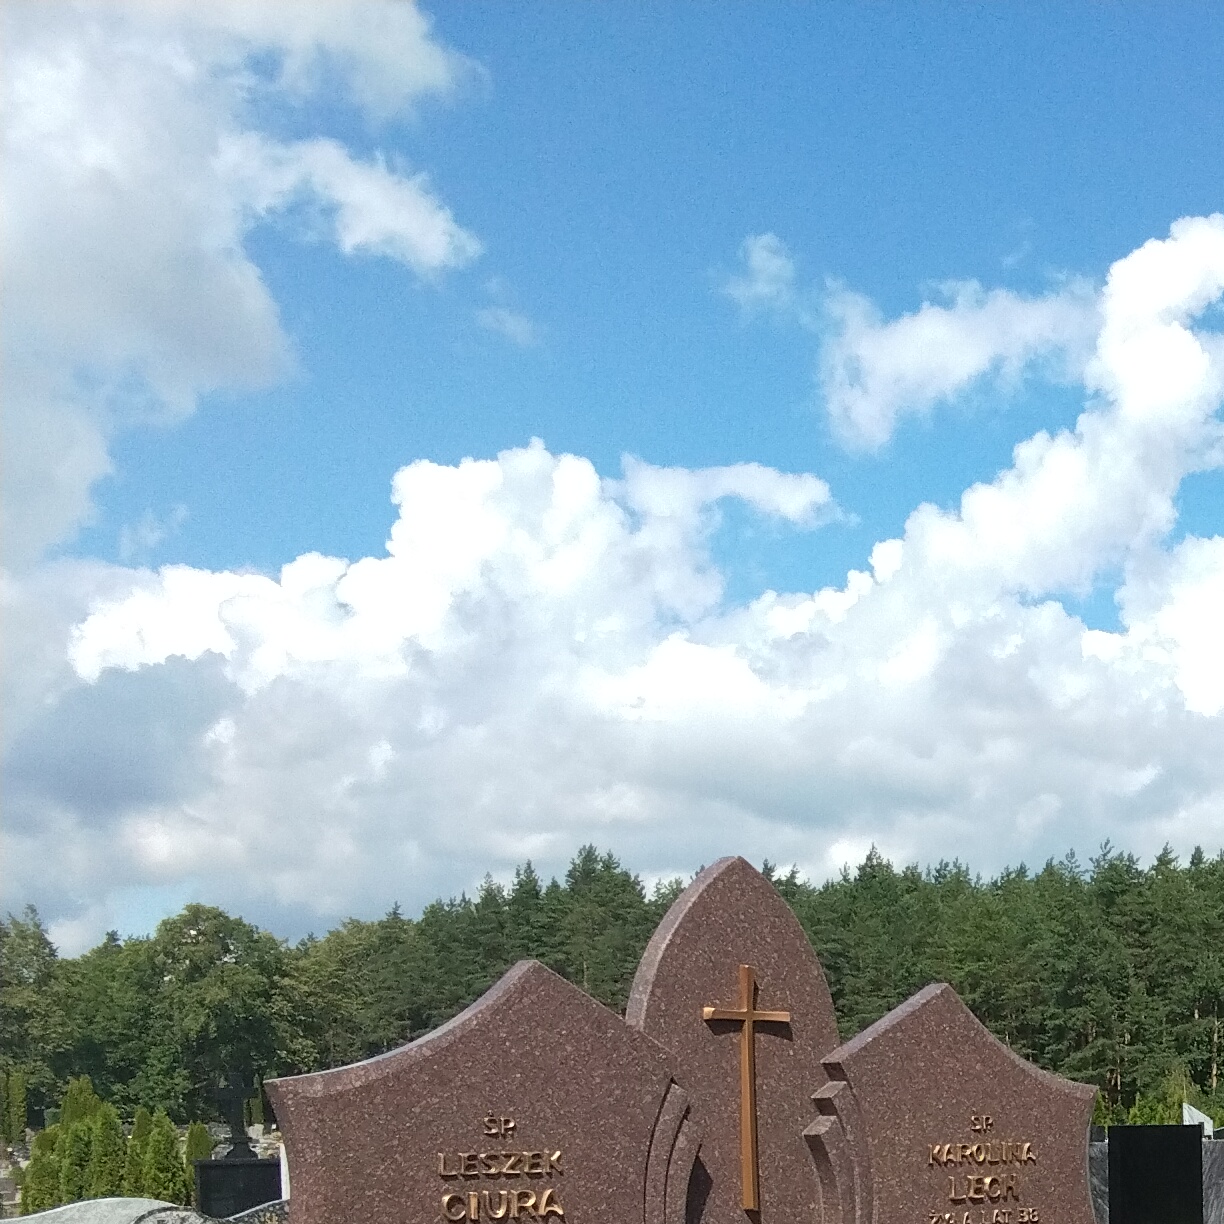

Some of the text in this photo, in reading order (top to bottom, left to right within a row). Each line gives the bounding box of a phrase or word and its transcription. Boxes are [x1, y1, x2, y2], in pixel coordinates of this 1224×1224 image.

[437, 1150, 564, 1178] LESZEK
[927, 1142, 1037, 1165] KAROLINA
[948, 1173, 1019, 1200] LECH
[442, 1189, 565, 1221] CIURA
